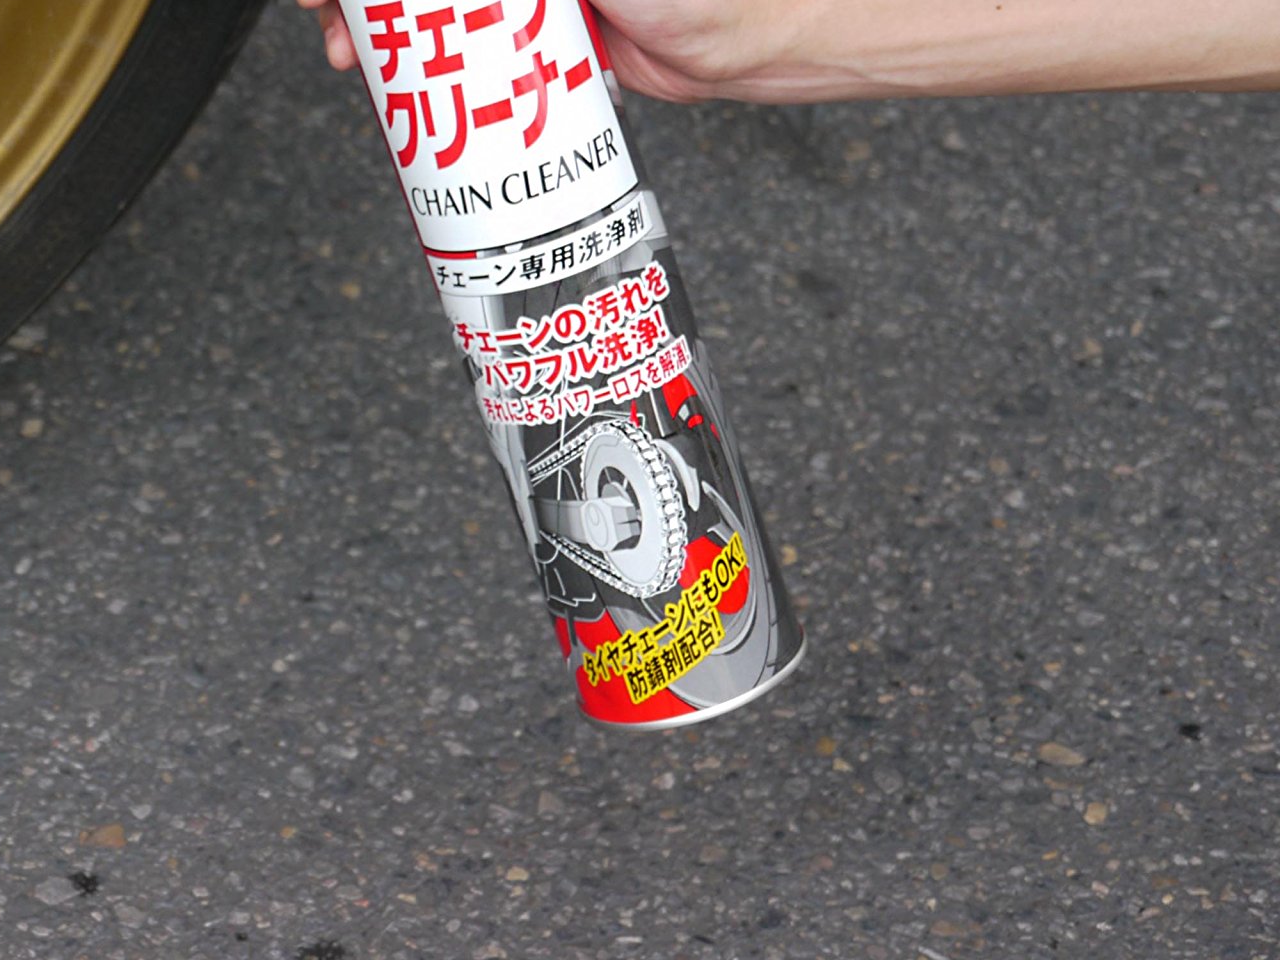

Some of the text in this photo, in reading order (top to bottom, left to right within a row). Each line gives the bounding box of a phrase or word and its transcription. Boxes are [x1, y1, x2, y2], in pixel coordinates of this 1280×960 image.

[386, 50, 593, 170] クリーナー
[412, 128, 619, 216] CHAIN CLEANER
[436, 203, 645, 288] チェーン専用洗浄剤
[456, 265, 668, 353] チェーンの汚れを
